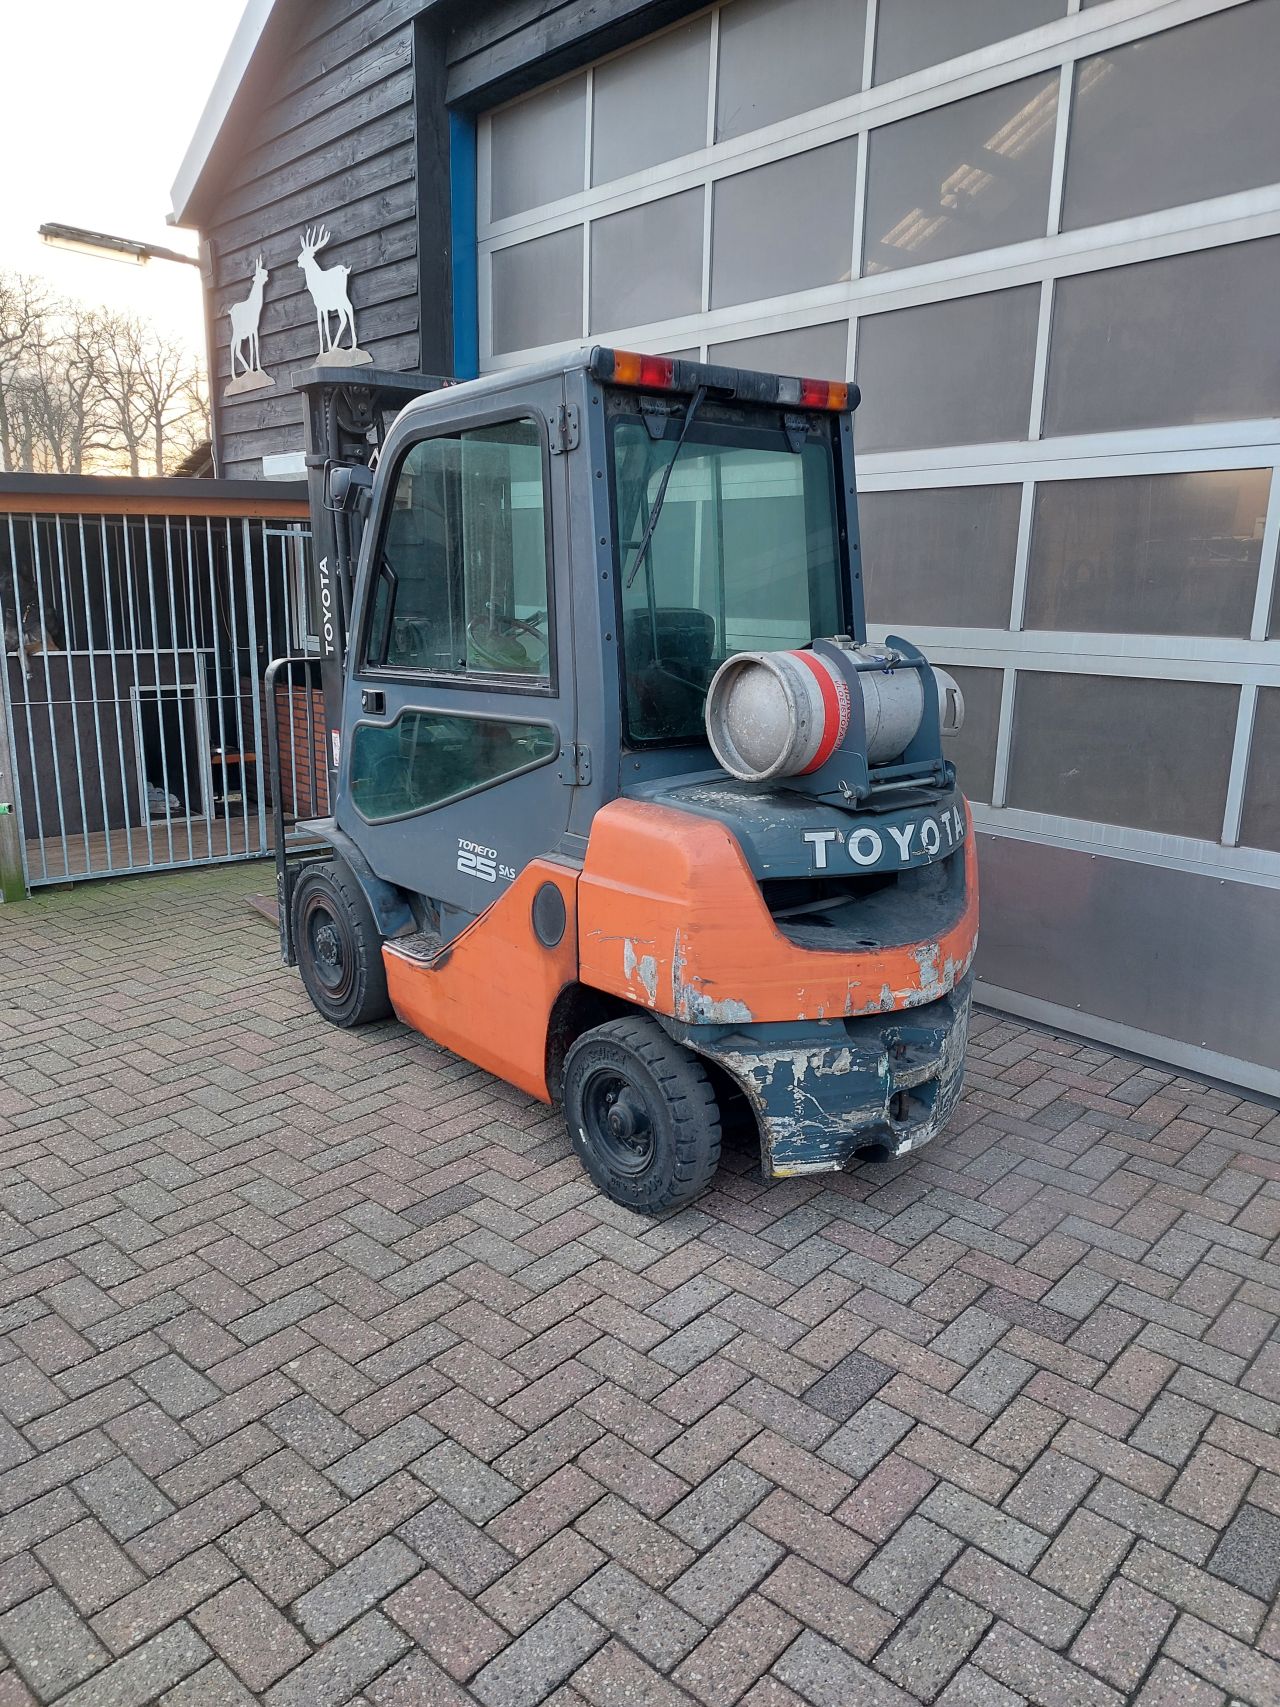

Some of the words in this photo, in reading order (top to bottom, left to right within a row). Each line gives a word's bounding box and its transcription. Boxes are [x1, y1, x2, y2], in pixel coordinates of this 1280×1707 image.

[320, 556, 334, 656] TOYOTA
[457, 838, 497, 858] TONERO
[804, 805, 964, 868] TOYOTA
[457, 850, 497, 883] 25
[498, 864, 516, 879] SAS
